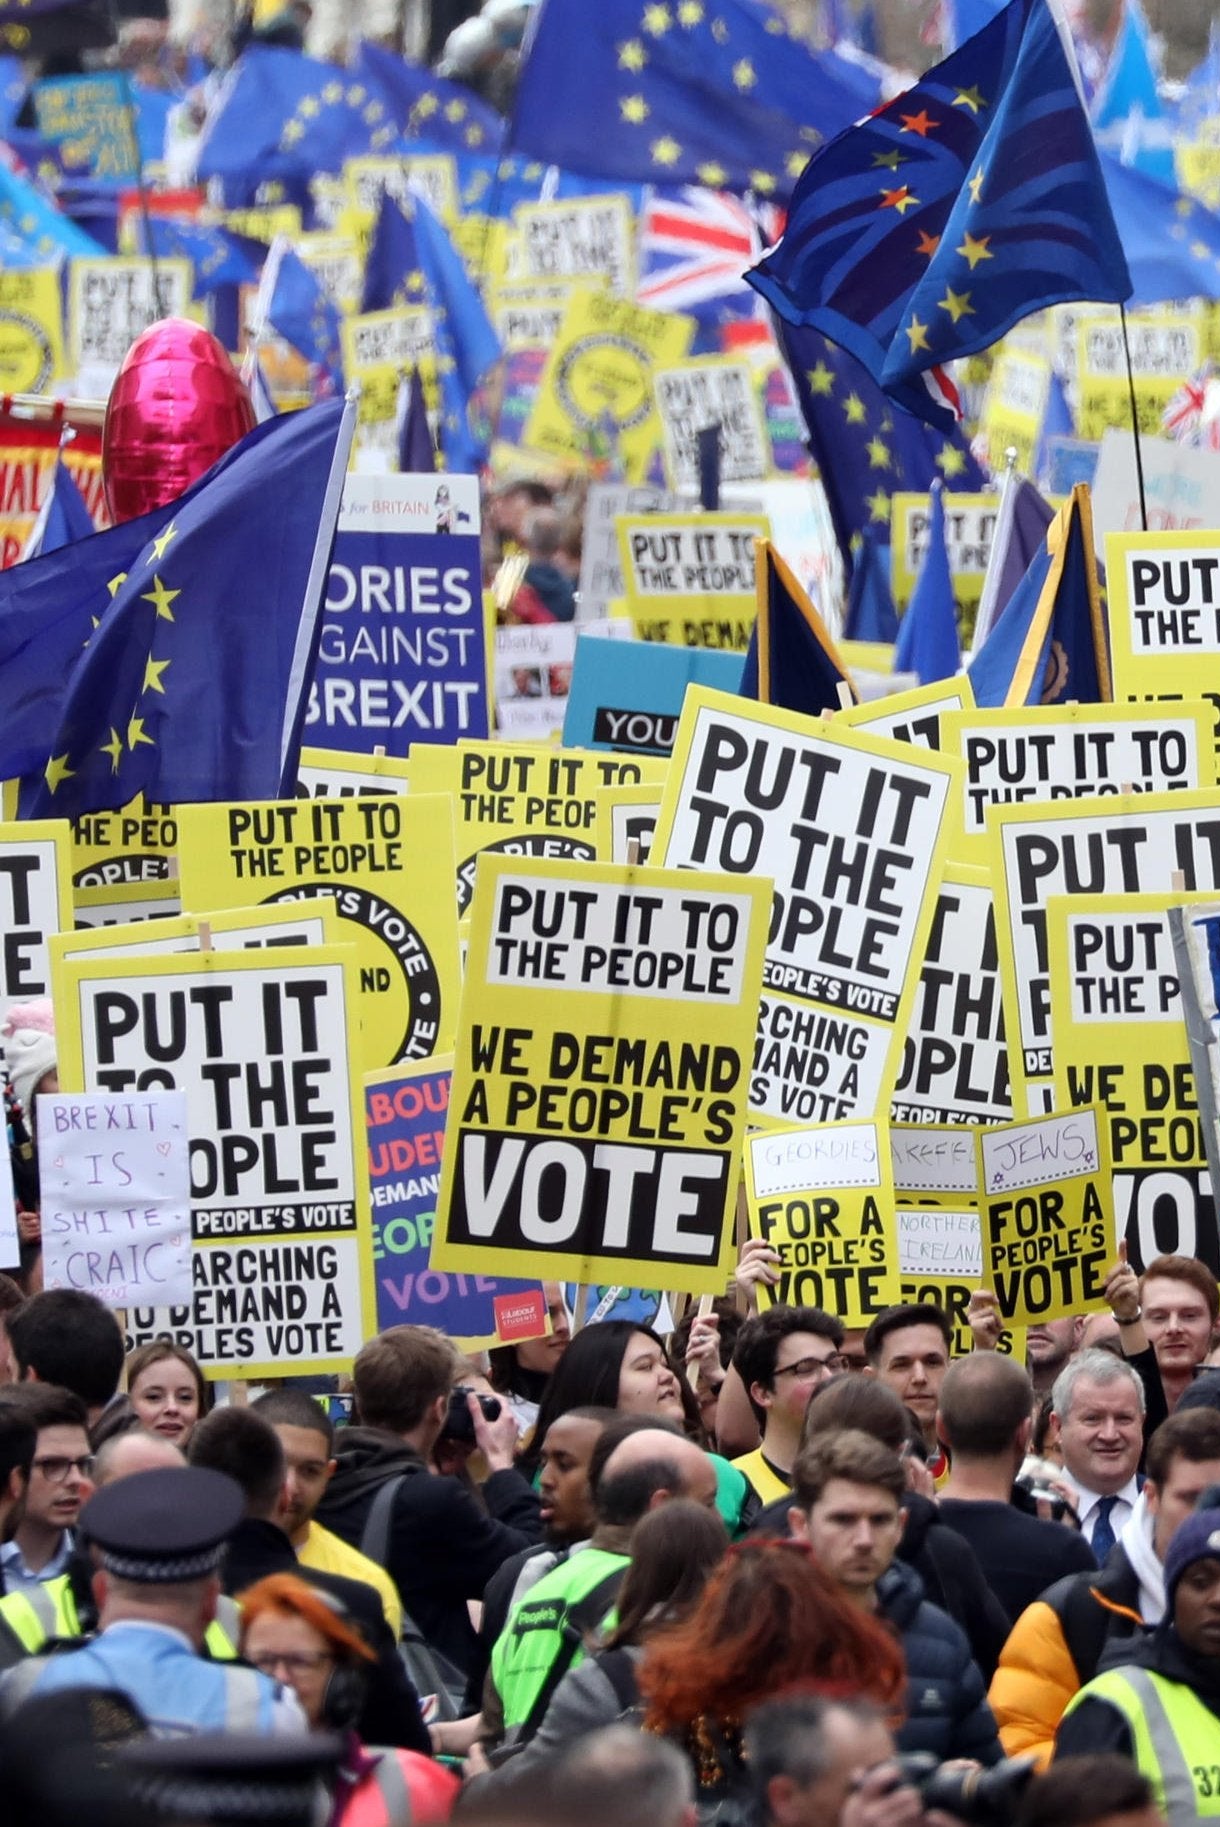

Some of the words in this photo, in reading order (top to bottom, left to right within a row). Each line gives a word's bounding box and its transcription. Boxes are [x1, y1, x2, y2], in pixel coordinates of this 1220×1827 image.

[372, 499, 430, 515] BRITAIN
[632, 532, 682, 563] PUT
[694, 533, 715, 562] IT
[638, 565, 678, 589] THE
[1132, 557, 1219, 606] PUT
[1133, 609, 1203, 647] THE
[461, 752, 536, 793] PUT
[548, 758, 584, 797] IT
[967, 735, 1056, 784] PUT
[1073, 732, 1115, 780] IT
[1131, 729, 1188, 776] TO
[695, 722, 843, 822] PUT
[855, 766, 932, 847] IT
[228, 807, 297, 847] PUT
[312, 803, 354, 843] IT
[358, 802, 401, 840] TO
[460, 793, 515, 825] THE
[230, 847, 285, 878] THE
[294, 842, 403, 875] PEOPLE
[689, 795, 765, 874] TO
[789, 821, 915, 919] THE
[1015, 826, 1148, 905] PUT
[366, 900, 429, 977] VOTE
[497, 884, 599, 940] PUT
[612, 894, 663, 945] IT
[681, 899, 740, 953] TO
[494, 937, 571, 981] THE
[580, 948, 735, 995] PEOPLE
[1073, 921, 1163, 973] PUT
[846, 982, 898, 1018] VOTE
[1074, 976, 1146, 1015] THE
[93, 984, 234, 1064] PUT
[261, 979, 329, 1057] IT
[470, 1023, 534, 1077] WE
[549, 1031, 742, 1093] DEMAND
[838, 1062, 860, 1098] A
[201, 1057, 335, 1131] THE
[780, 1084, 856, 1123] VOTE
[1066, 1063, 1126, 1112] WE
[53, 1102, 159, 1133] BREXIT
[461, 1078, 490, 1125] A
[505, 1081, 736, 1145] PEOPLE'S
[84, 1151, 133, 1187] IS
[765, 1134, 877, 1168] GEORDIES
[993, 1124, 1085, 1172] JEWS
[462, 1133, 726, 1257] VOTE
[757, 1197, 841, 1240] FOR
[859, 1195, 885, 1236] A
[989, 1190, 1066, 1244] FOR
[1082, 1181, 1104, 1224] A
[52, 1207, 163, 1235] SHITE
[196, 1207, 296, 1235] PEOPLE'S
[301, 1204, 354, 1228] VOTE
[66, 1242, 168, 1289] CRAIC
[991, 1224, 1105, 1270] PEOPLE'S
[321, 1282, 342, 1319] A
[766, 1266, 890, 1315] VOTE
[993, 1250, 1107, 1318] VOTE
[266, 1321, 343, 1357] VOTE
